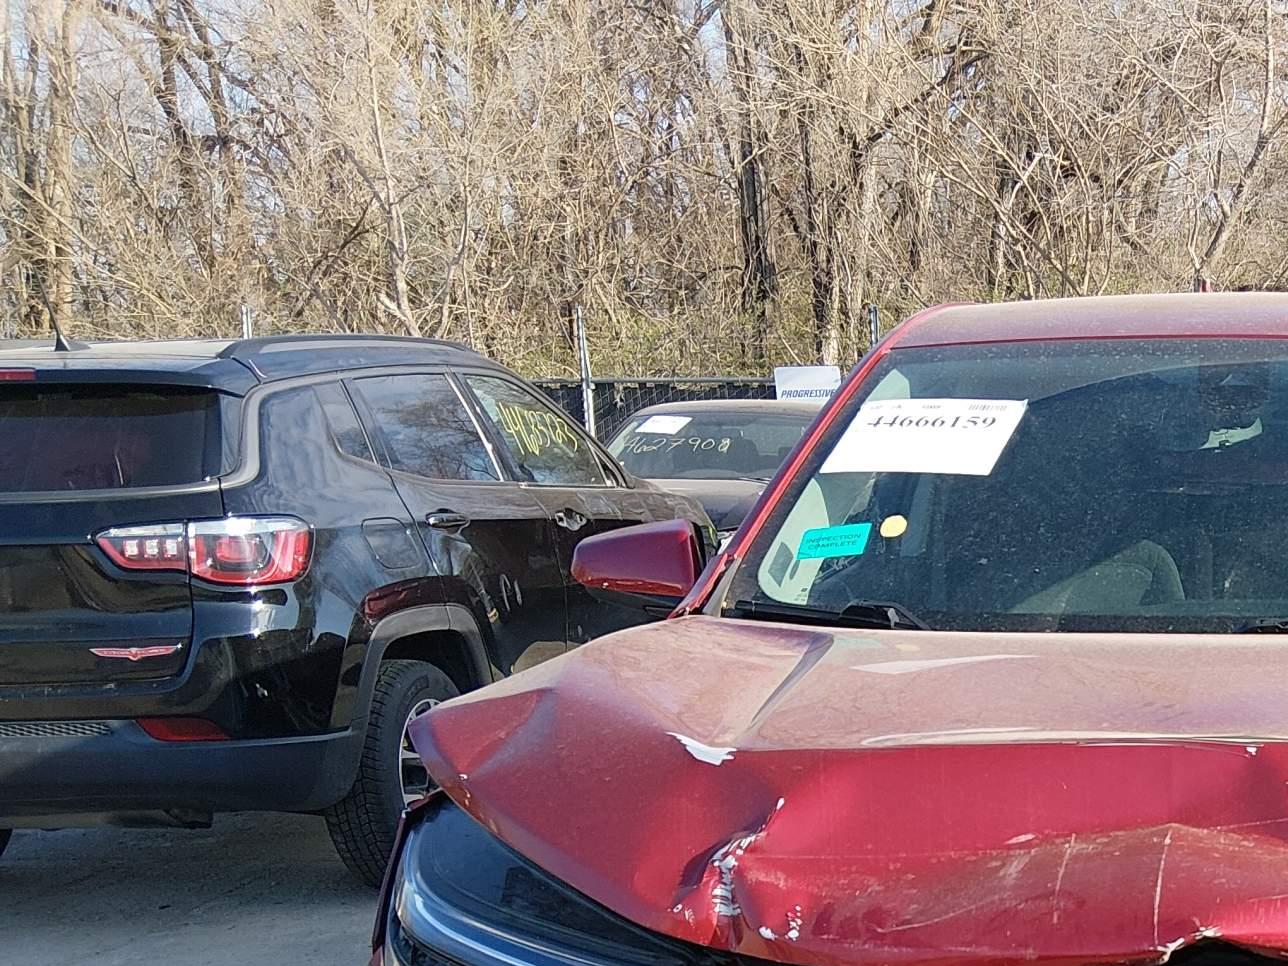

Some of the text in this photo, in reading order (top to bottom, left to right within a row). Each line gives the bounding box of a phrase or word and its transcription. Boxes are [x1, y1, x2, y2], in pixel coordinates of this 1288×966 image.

[867, 415, 997, 429] 44666159
[806, 534, 861, 544] INSPECTION
[807, 540, 857, 550] COMPLETE
